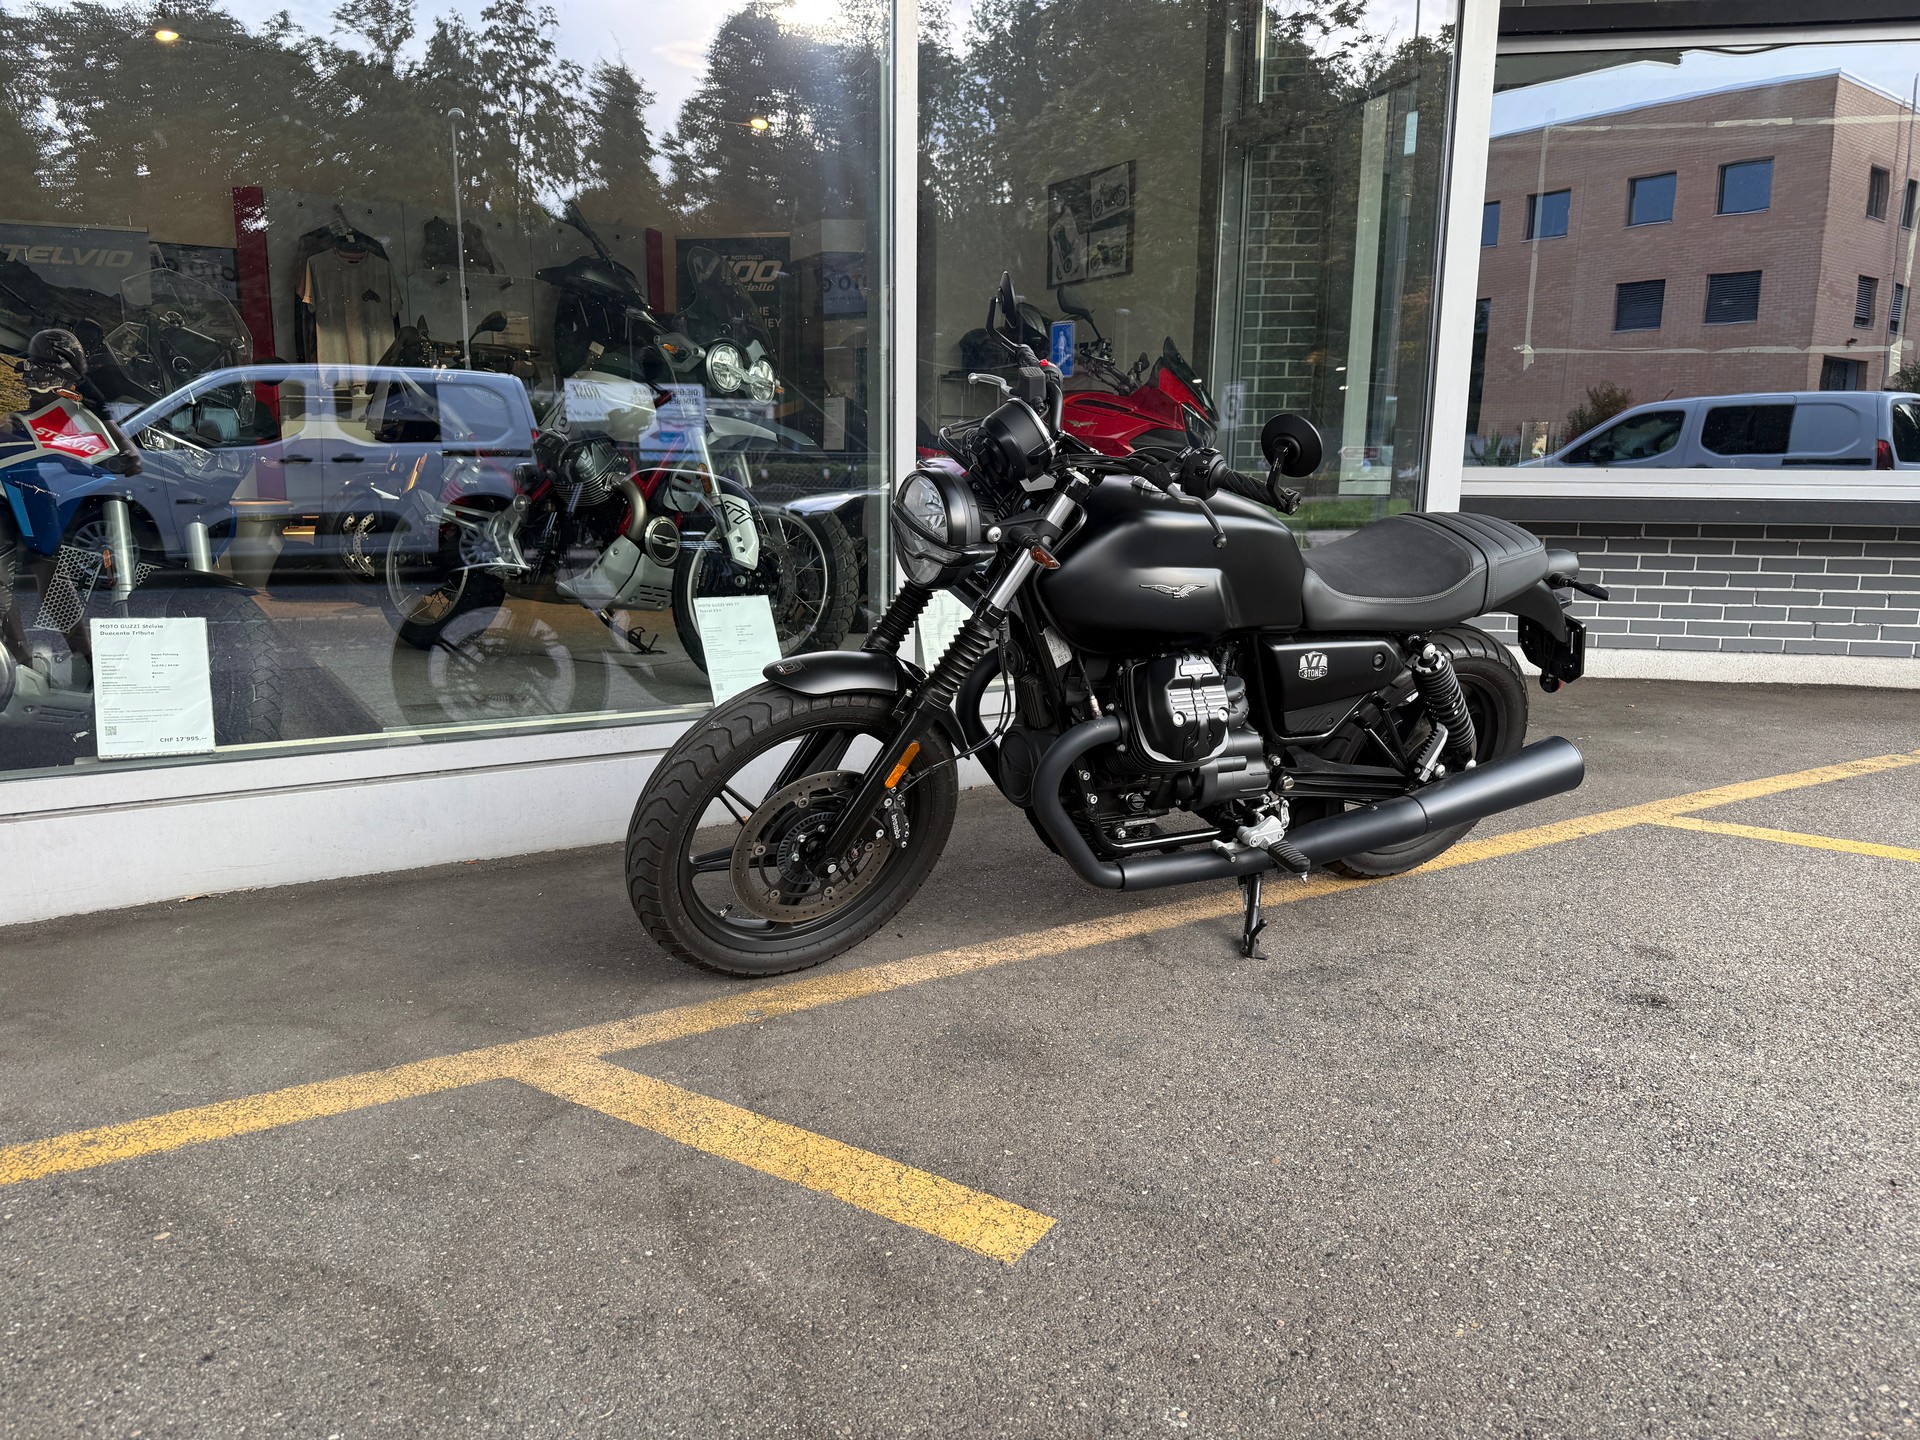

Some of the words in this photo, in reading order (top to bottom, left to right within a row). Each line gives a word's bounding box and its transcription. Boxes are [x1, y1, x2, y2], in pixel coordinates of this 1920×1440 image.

[0, 243, 134, 268] TELVIO
[1304, 653, 1323, 668] V7
[1303, 668, 1323, 678] STONE
[891, 813, 901, 840] brembo
